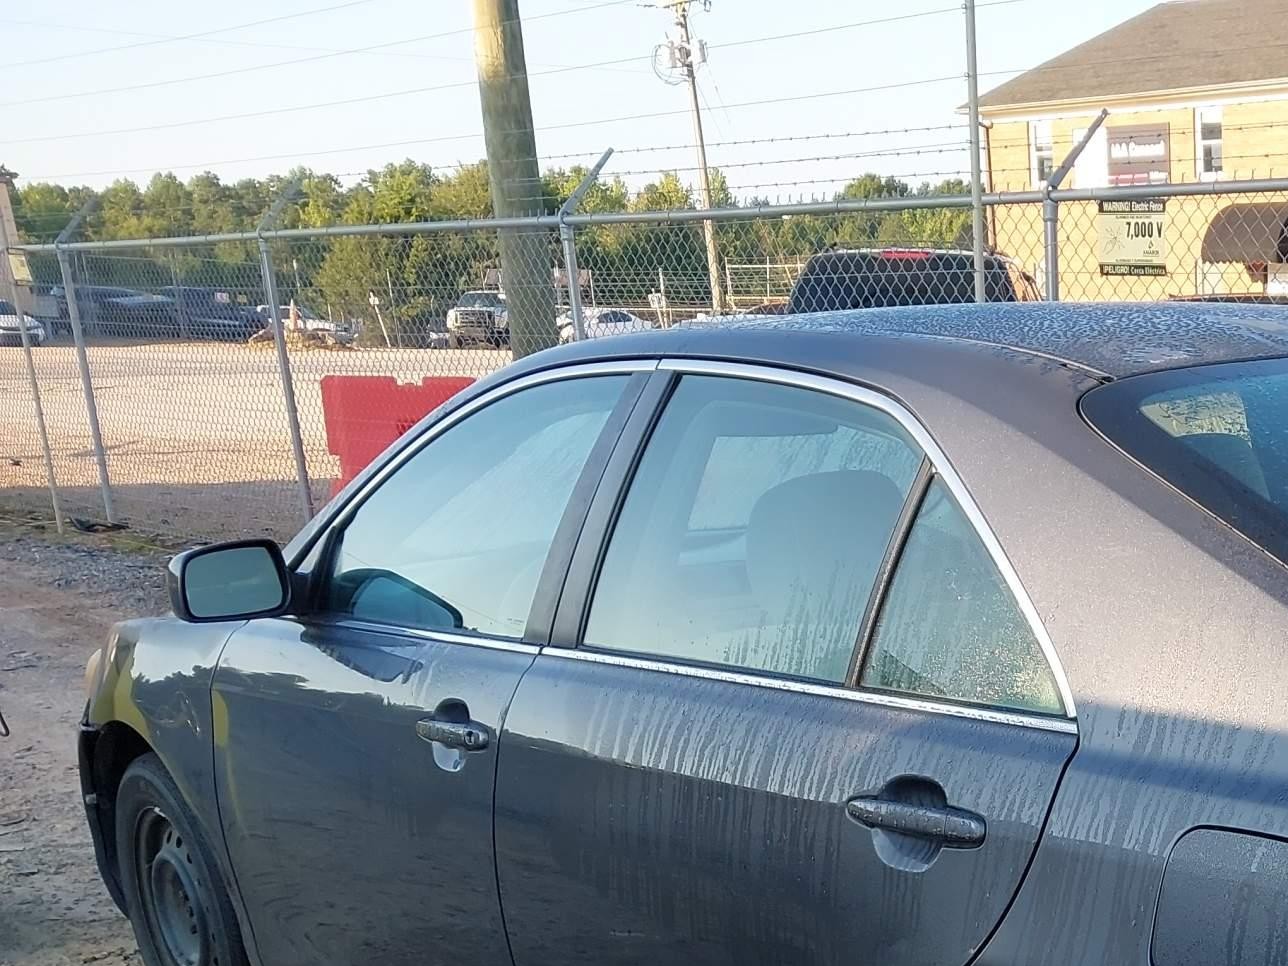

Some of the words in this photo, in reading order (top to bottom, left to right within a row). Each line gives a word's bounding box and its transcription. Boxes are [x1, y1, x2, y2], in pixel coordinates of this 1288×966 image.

[1103, 201, 1131, 211] WARNING!
[1126, 221, 1154, 240] 7,000
[1156, 221, 1163, 238] V
